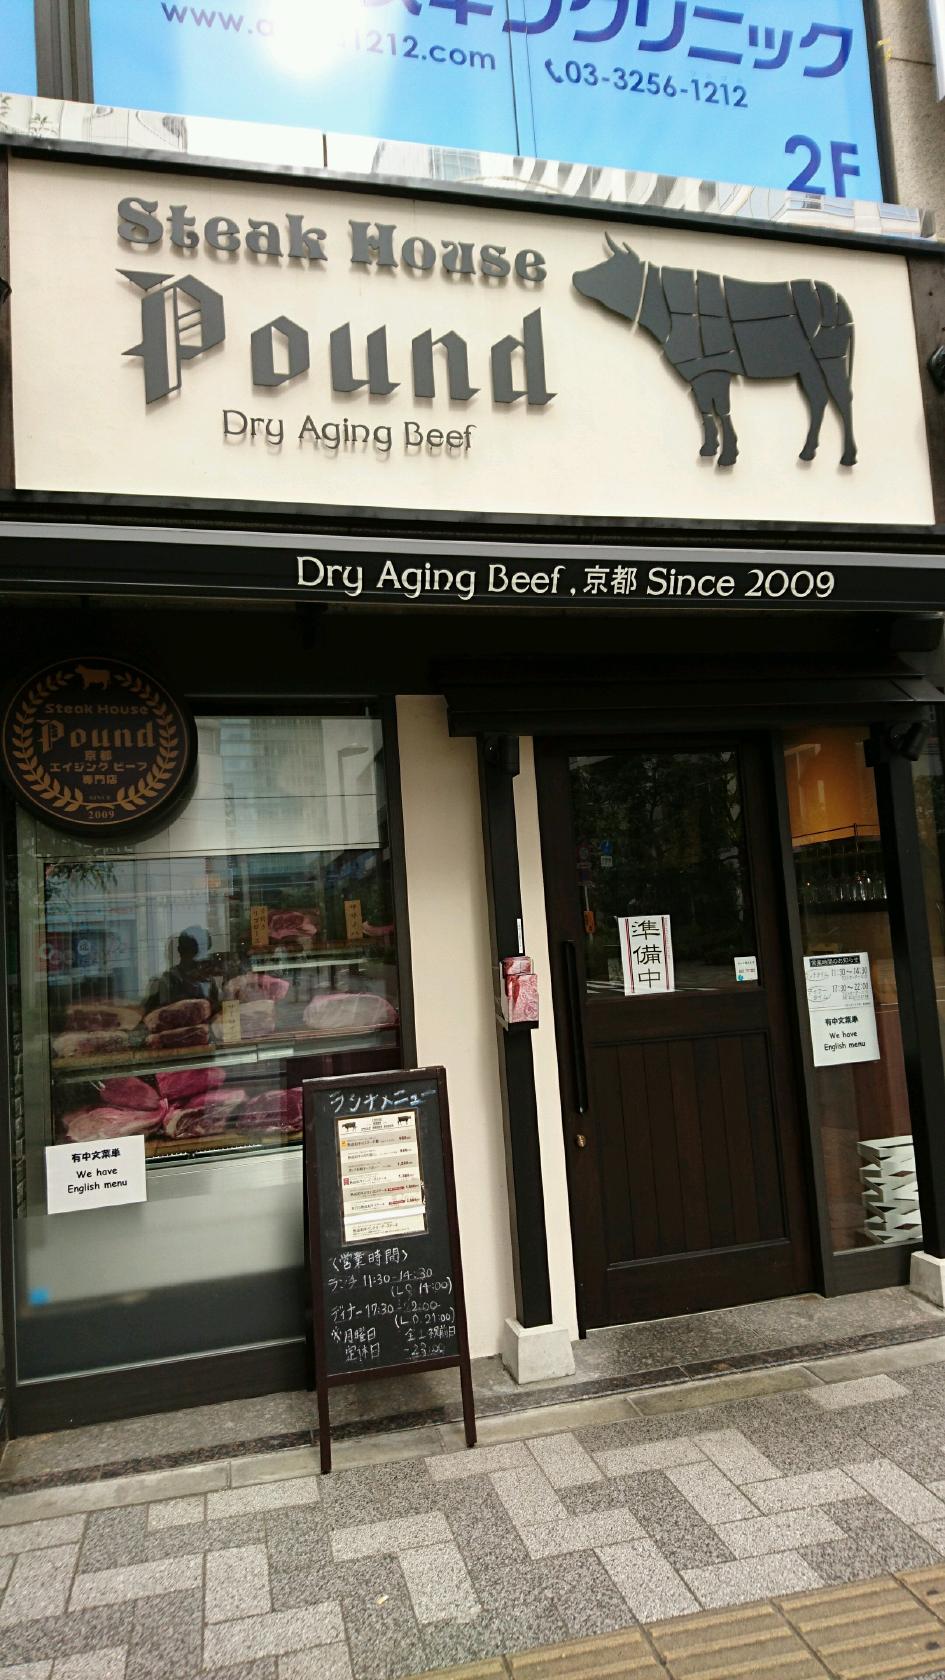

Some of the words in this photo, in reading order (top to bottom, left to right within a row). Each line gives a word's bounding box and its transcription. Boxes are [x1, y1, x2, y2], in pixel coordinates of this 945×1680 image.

[565, 60, 749, 108] 03-3256-1212
[784, 134, 861, 198] 2F
[117, 196, 328, 262] Steak
[347, 219, 547, 283] House
[115, 268, 559, 406] Pound
[222, 409, 285, 446] Dry
[298, 415, 393, 452] Aging
[404, 421, 477, 451] Beef
[296, 556, 364, 597] Dry
[376, 560, 476, 601] Aging
[582, 565, 638, 595] 京都
[646, 567, 735, 597] Since
[744, 569, 836, 599] 2009
[44, 703, 93, 715] Steak
[97, 703, 149, 716] House
[35, 718, 157, 754] Pound
[87, 809, 115, 820] 2009
[631, 919, 662, 989] 準備中
[824, 1041, 847, 1052] English
[848, 1040, 866, 1048] menu
[829, 1031, 840, 1039] We
[842, 1030, 858, 1038] have
[67, 1181, 100, 1195] English
[104, 1179, 128, 1189] menu
[76, 1170, 92, 1179] We
[96, 1167, 118, 1177] have
